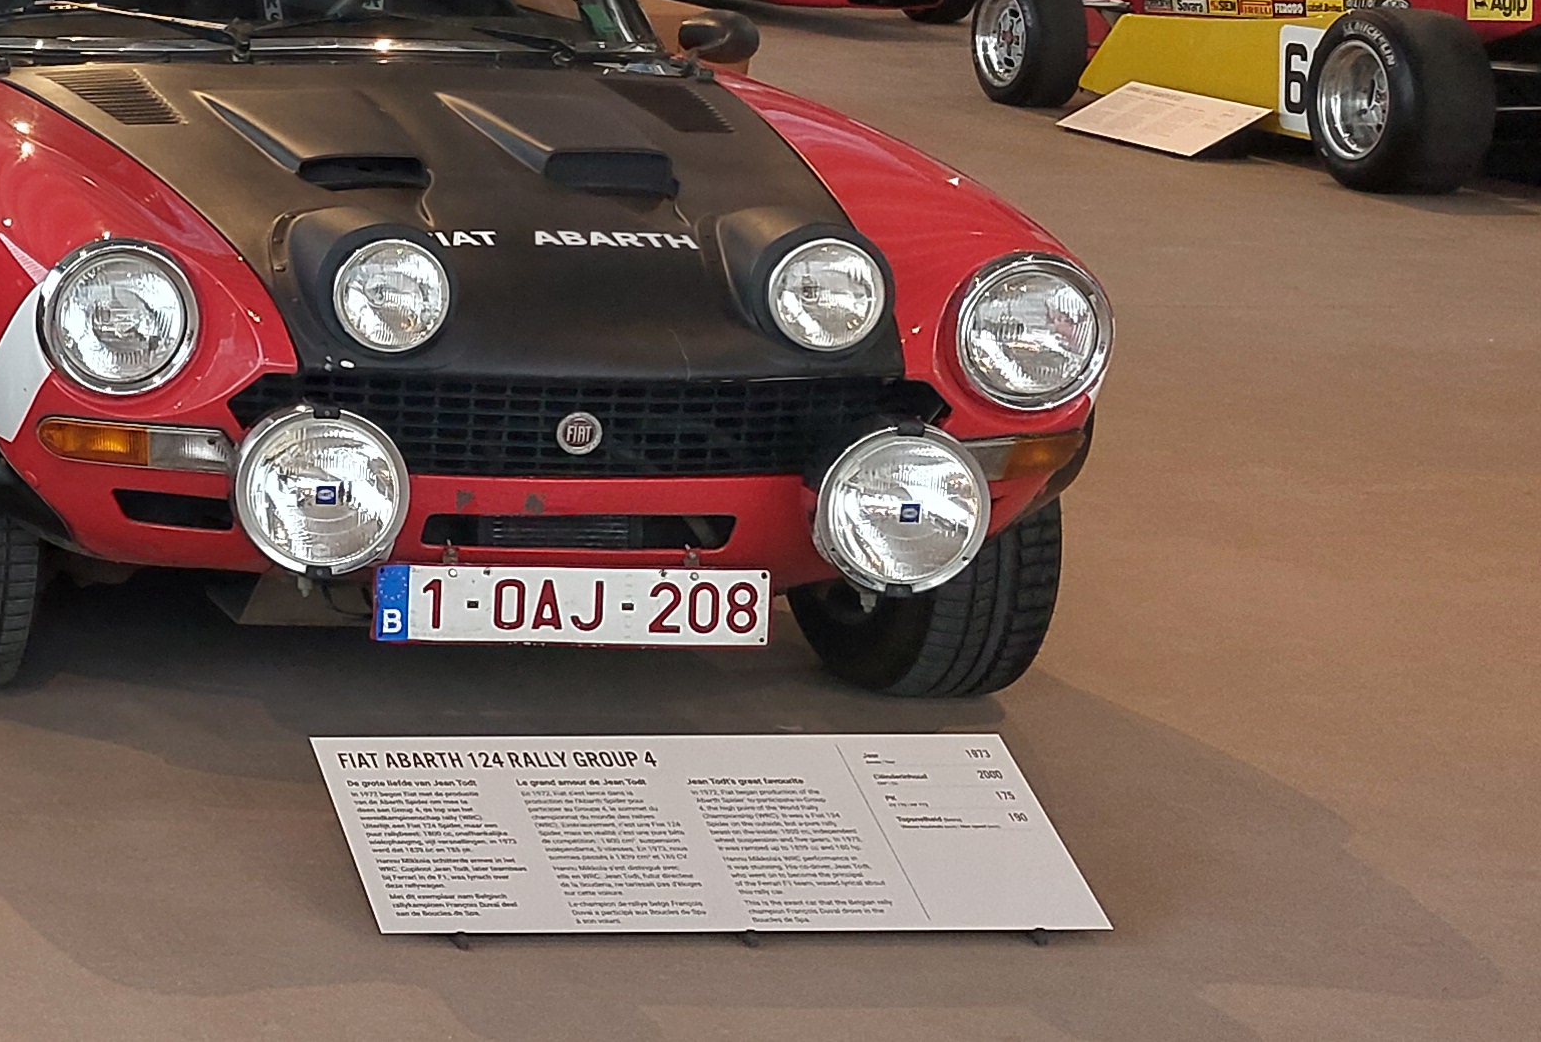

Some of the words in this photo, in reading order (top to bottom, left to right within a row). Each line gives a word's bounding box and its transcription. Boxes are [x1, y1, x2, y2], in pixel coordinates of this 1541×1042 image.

[1285, 42, 1308, 115] 6
[428, 231, 497, 247] IAT
[534, 230, 701, 249] ABARTH
[566, 425, 593, 443] FIAT
[382, 608, 403, 634] B
[337, 752, 379, 769] FIAT
[385, 752, 463, 769] ABARTH
[467, 752, 505, 769] 124
[506, 752, 567, 769] RALLY
[573, 752, 638, 769] GROUP
[644, 752, 657, 769] 4
[965, 749, 991, 758] 1973
[977, 770, 1004, 780] 2000
[995, 791, 1016, 800] 175
[1008, 812, 1029, 822] 190
